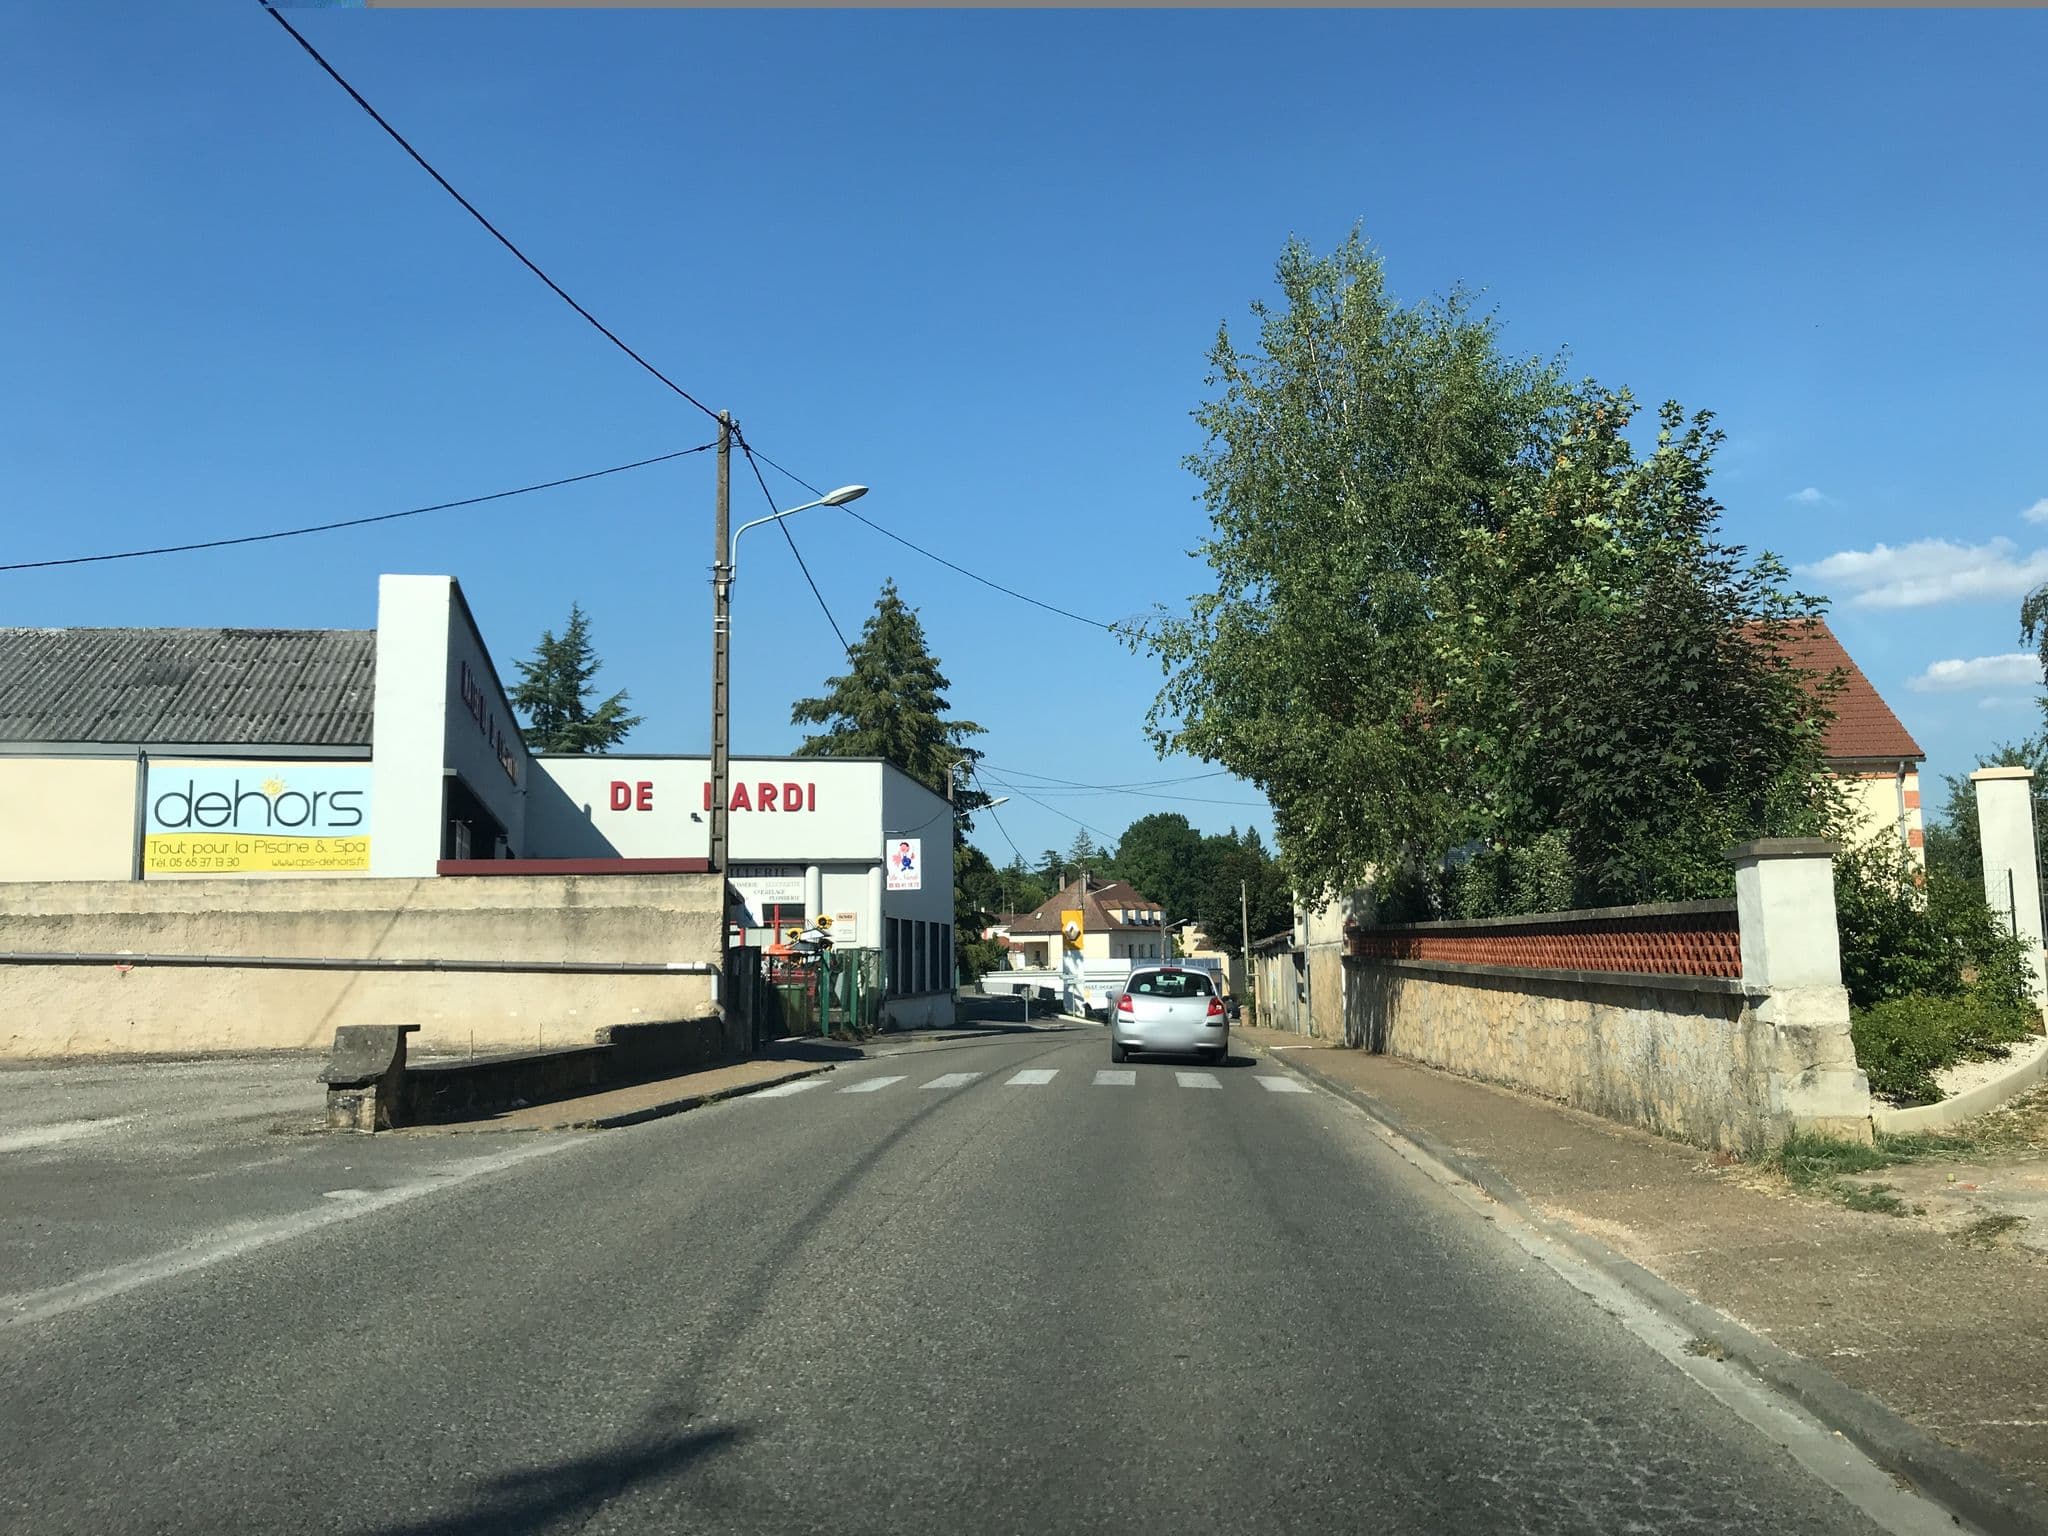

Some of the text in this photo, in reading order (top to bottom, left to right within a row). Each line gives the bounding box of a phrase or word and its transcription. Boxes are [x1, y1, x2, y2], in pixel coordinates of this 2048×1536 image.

[154, 779, 363, 828] dehors
[610, 781, 654, 812] DE
[150, 839, 366, 856] Tout pour la Piscine & Spa
[169, 858, 182, 868] 05
[185, 858, 198, 868] 65
[200, 858, 212, 867] 37
[226, 858, 240, 867] 30
